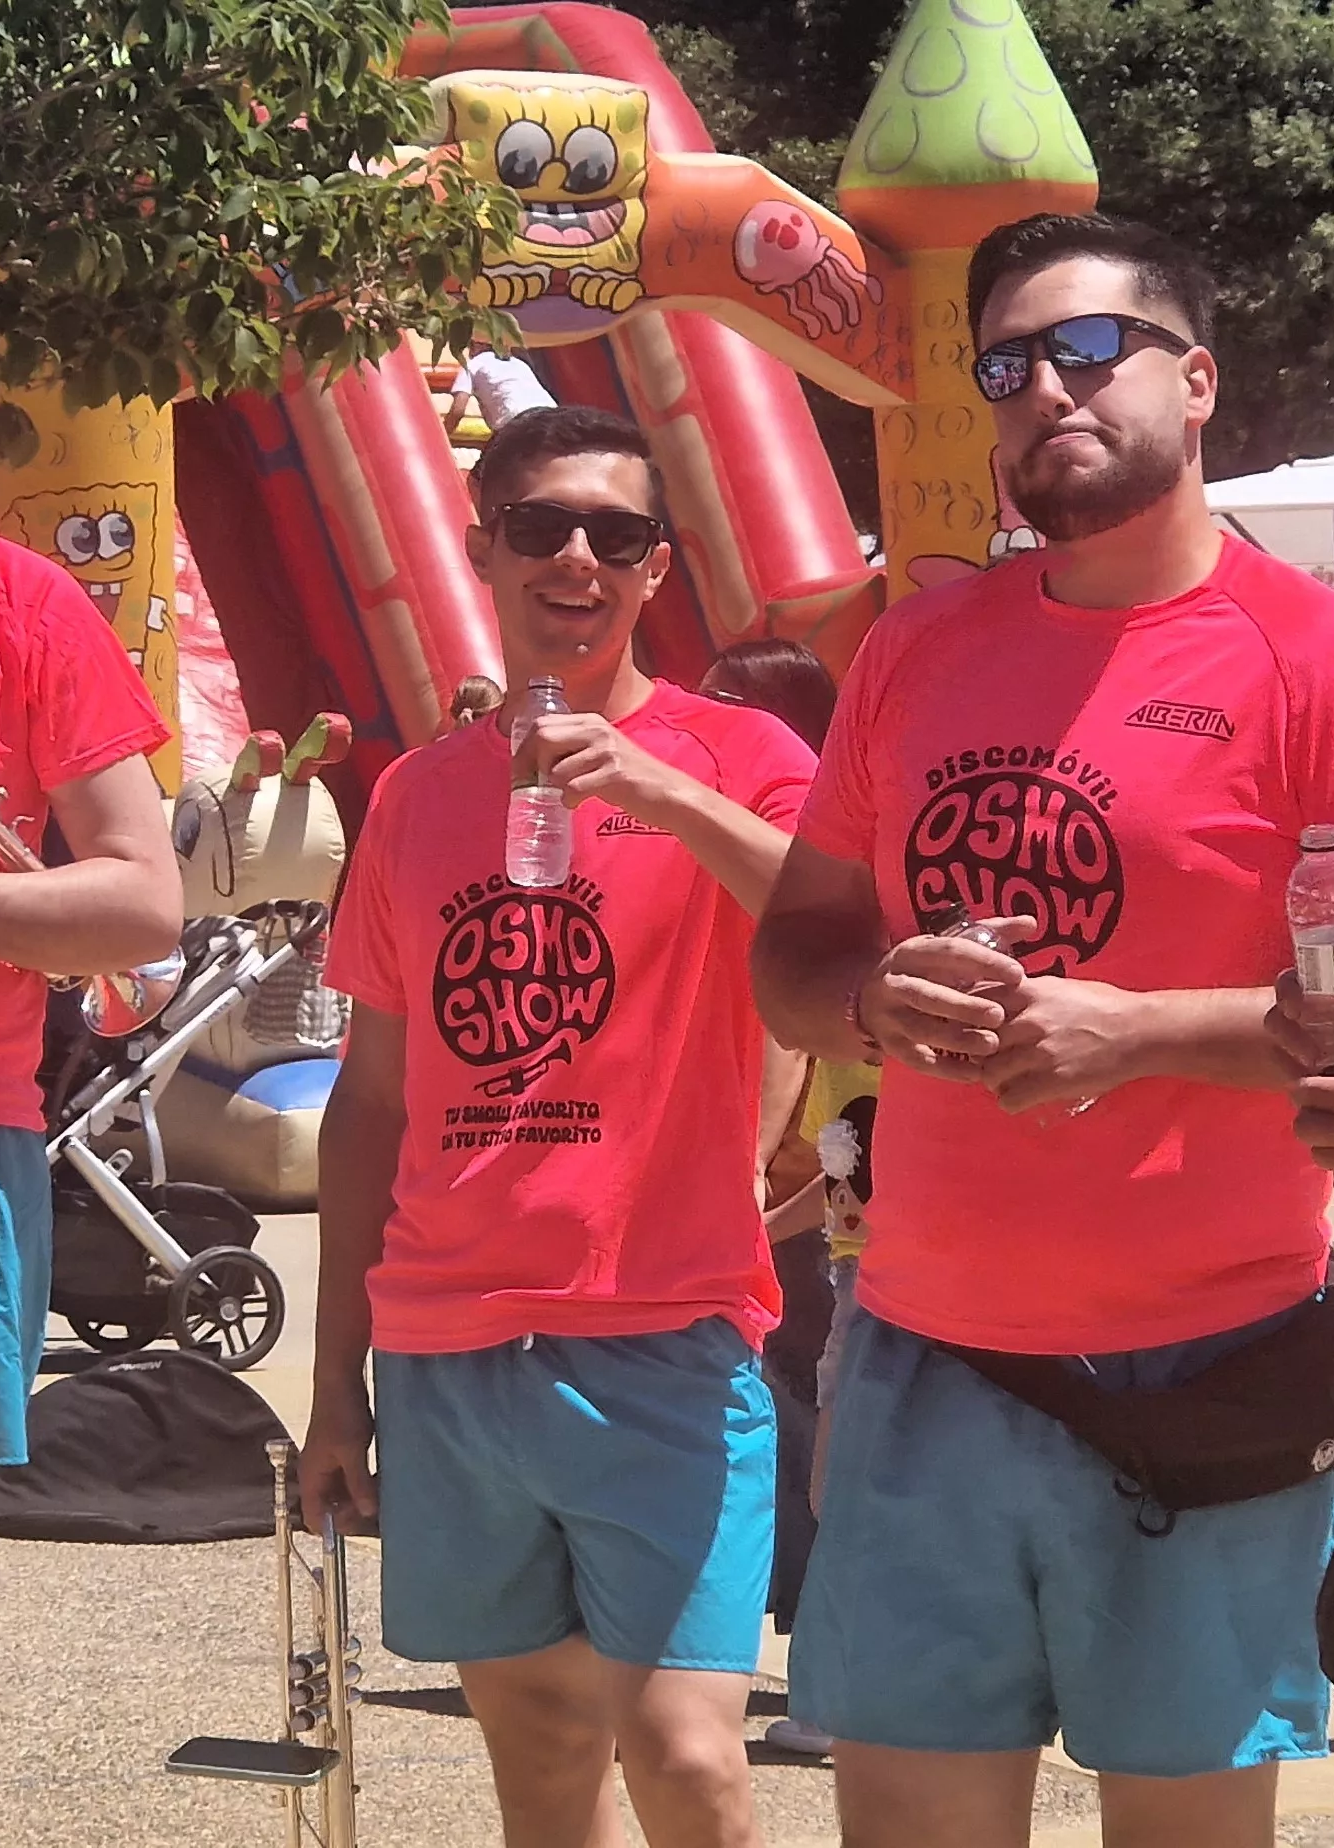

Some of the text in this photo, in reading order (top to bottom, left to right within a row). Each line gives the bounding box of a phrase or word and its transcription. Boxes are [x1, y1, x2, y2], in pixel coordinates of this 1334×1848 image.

[1125, 699, 1235, 741] ALBERTIN
[916, 779, 1109, 885] OSMO
[443, 901, 602, 979] OSMO
[443, 977, 608, 1055] SHOW
